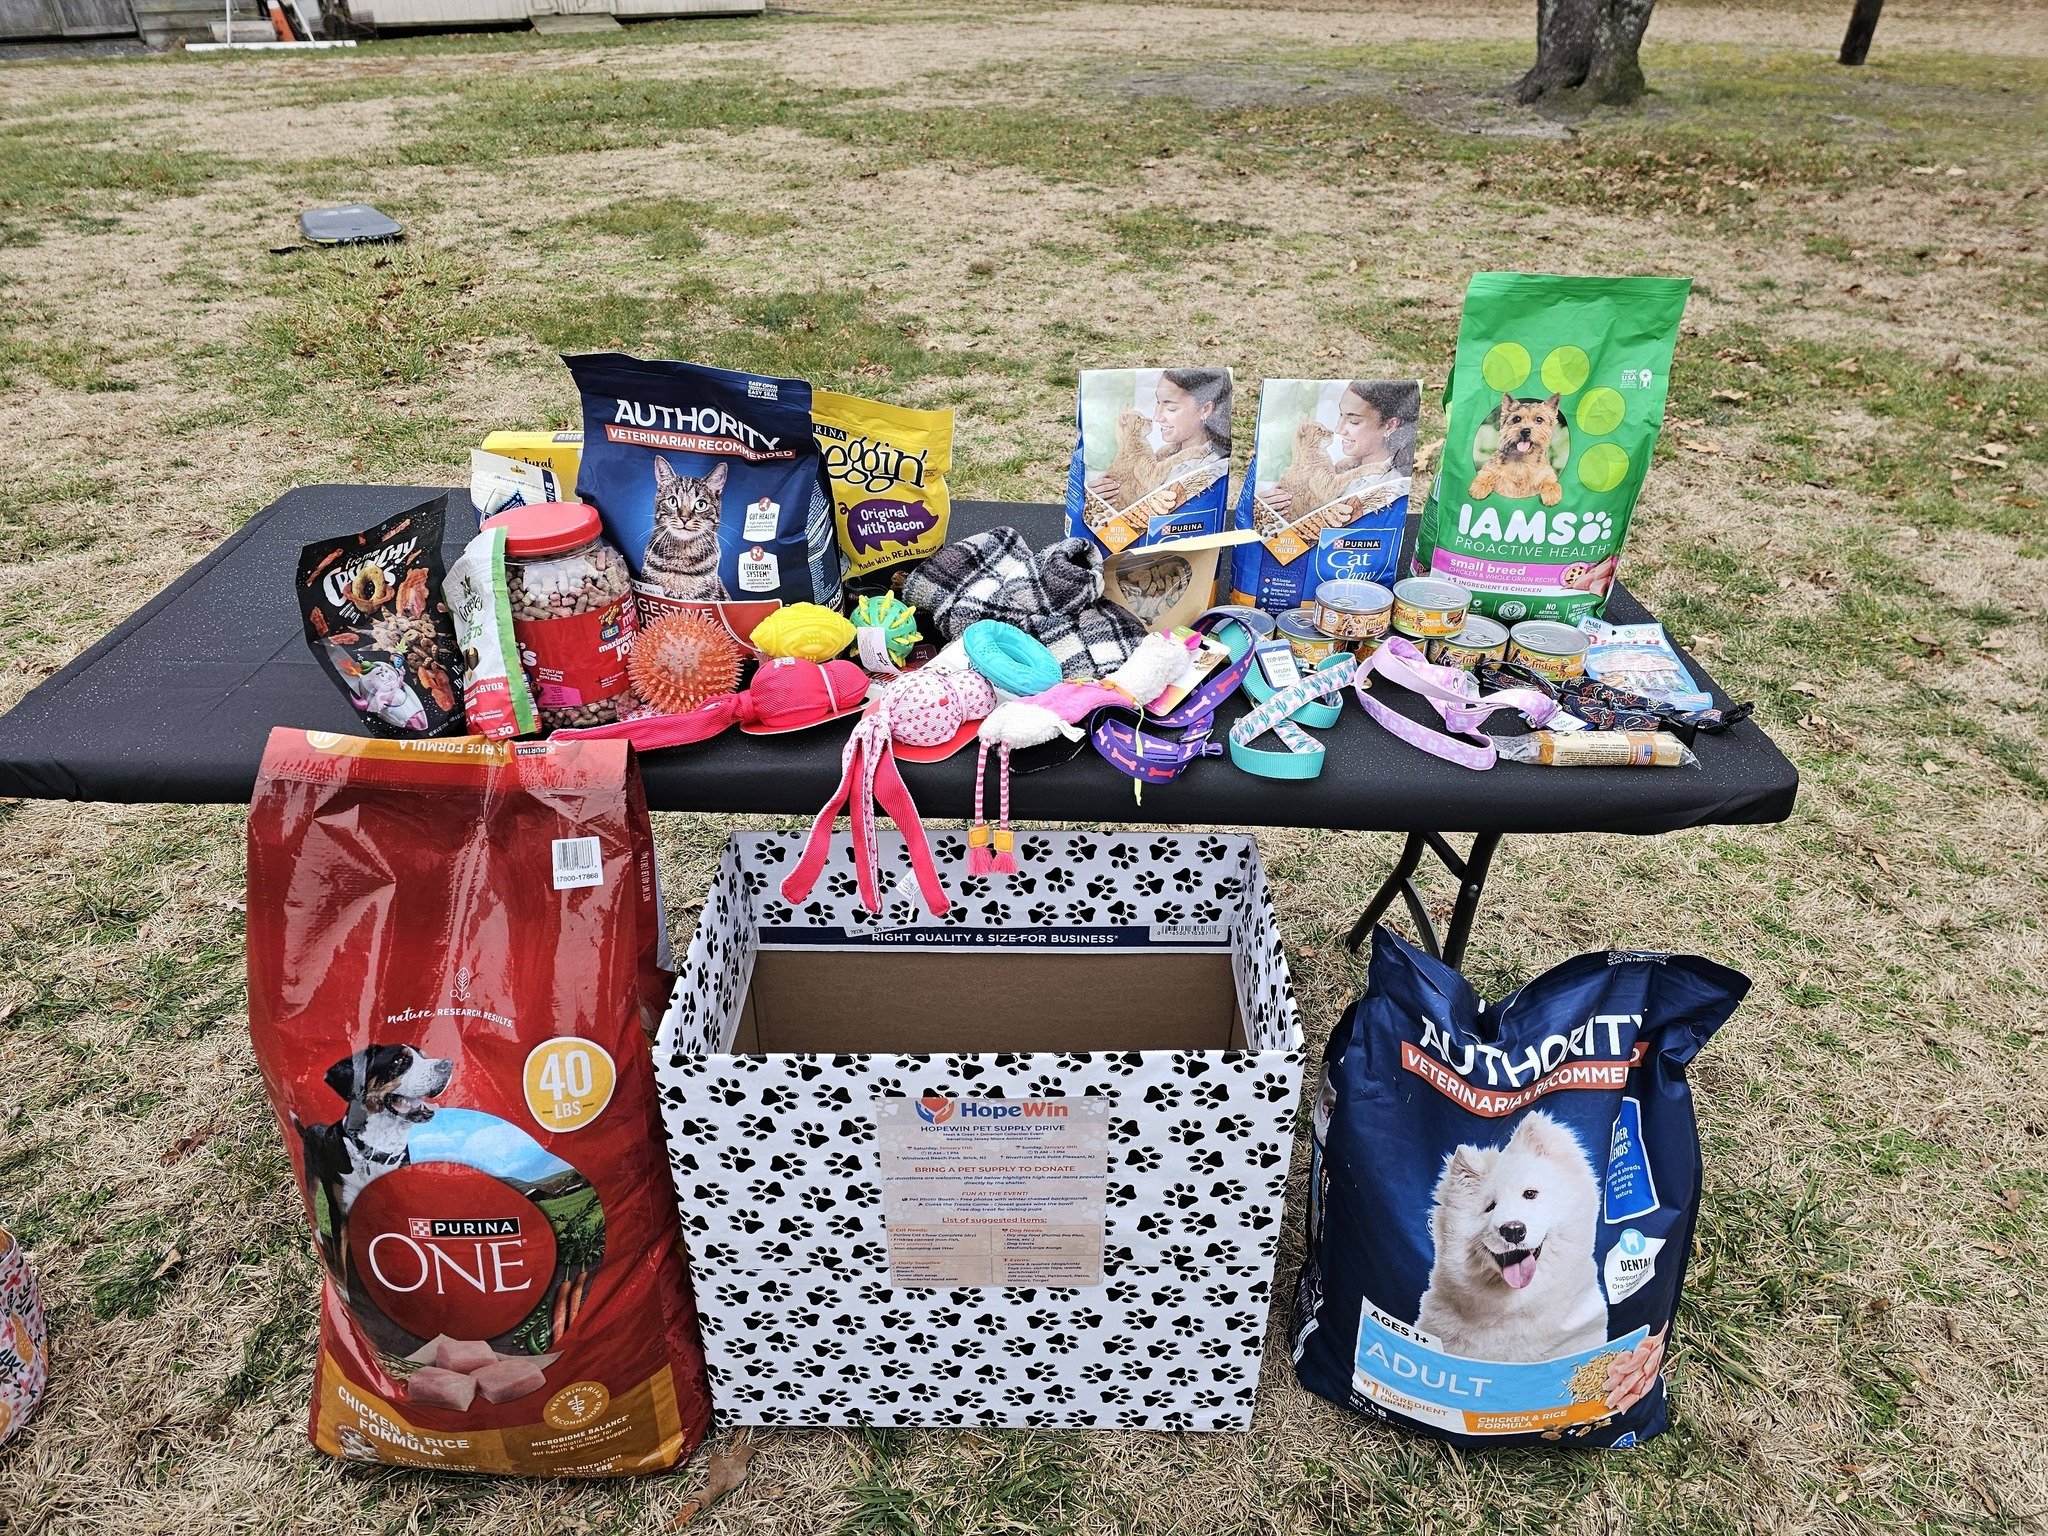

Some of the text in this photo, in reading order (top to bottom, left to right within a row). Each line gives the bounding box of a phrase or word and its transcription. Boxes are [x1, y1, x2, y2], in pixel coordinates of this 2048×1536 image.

[614, 399, 780, 450] AUTHORITY
[815, 425, 846, 441] RINA
[610, 427, 793, 461] VETERINARIAN RECOMMENDED
[814, 436, 928, 492] eggin'
[860, 505, 908, 523] Original
[857, 519, 925, 537] With Bacon
[1110, 526, 1125, 534] WITH
[1172, 523, 1203, 532] PURINA
[1458, 503, 1578, 545] IAMS
[1275, 546, 1298, 554] CHICKEN
[1455, 536, 1608, 558] PROACTIVE HEALTH
[743, 563, 772, 571] LIVEBIOME
[858, 545, 937, 571] Made With REAL Bacon
[1327, 550, 1371, 569] Cat
[1450, 558, 1526, 575] small breed
[1335, 568, 1376, 580] Chow
[1449, 566, 1477, 578] CHICKEN
[1485, 573, 1510, 581] WHOLE
[1458, 580, 1501, 590] INGREDIENT
[599, 631, 633, 653] maximum
[1531, 660, 1560, 671] Friskies
[497, 725, 514, 736] 30
[399, 739, 494, 755] RICE FORMULA
[556, 872, 599, 882] 17800-17868
[915, 934, 971, 942] QUALITY
[975, 934, 984, 942] &
[988, 934, 1016, 942] SIZE
[1020, 934, 1047, 942] FOR
[1050, 934, 1113, 943] BUSINESS
[387, 1006, 514, 1028] nature. RESEARCH. RESULTS.
[539, 1050, 592, 1100] 40
[554, 1101, 581, 1120] LBS
[961, 1102, 1069, 1119] HopeWin
[1622, 1164, 1641, 1174] shreds
[435, 1221, 514, 1235] PURINA
[369, 1233, 532, 1294] ONE
[1615, 1274, 1637, 1282] support
[1371, 1310, 1429, 1344] AGES 1+
[1366, 1341, 1493, 1397] ADULT
[1363, 1379, 1379, 1396] #1
[550, 1386, 603, 1412] VETERINARIAN
[1349, 1395, 1363, 1407] NET
[1381, 1388, 1448, 1416] INGREDIENT
[338, 1385, 469, 1449] CHICKEN & RICE
[552, 1401, 602, 1425] RECOMMENDED
[1478, 1415, 1529, 1424] CHICKEN
[1542, 1410, 1568, 1419] RICE
[359, 1418, 445, 1457] FORMULA
[531, 1415, 629, 1447] MICROBIOME BALANCE
[545, 1447, 568, 1455] health
[576, 1439, 604, 1448] immune
[606, 1426, 632, 1440] support
[551, 1439, 583, 1449] Prebiotic
[584, 1433, 601, 1441] fiber
